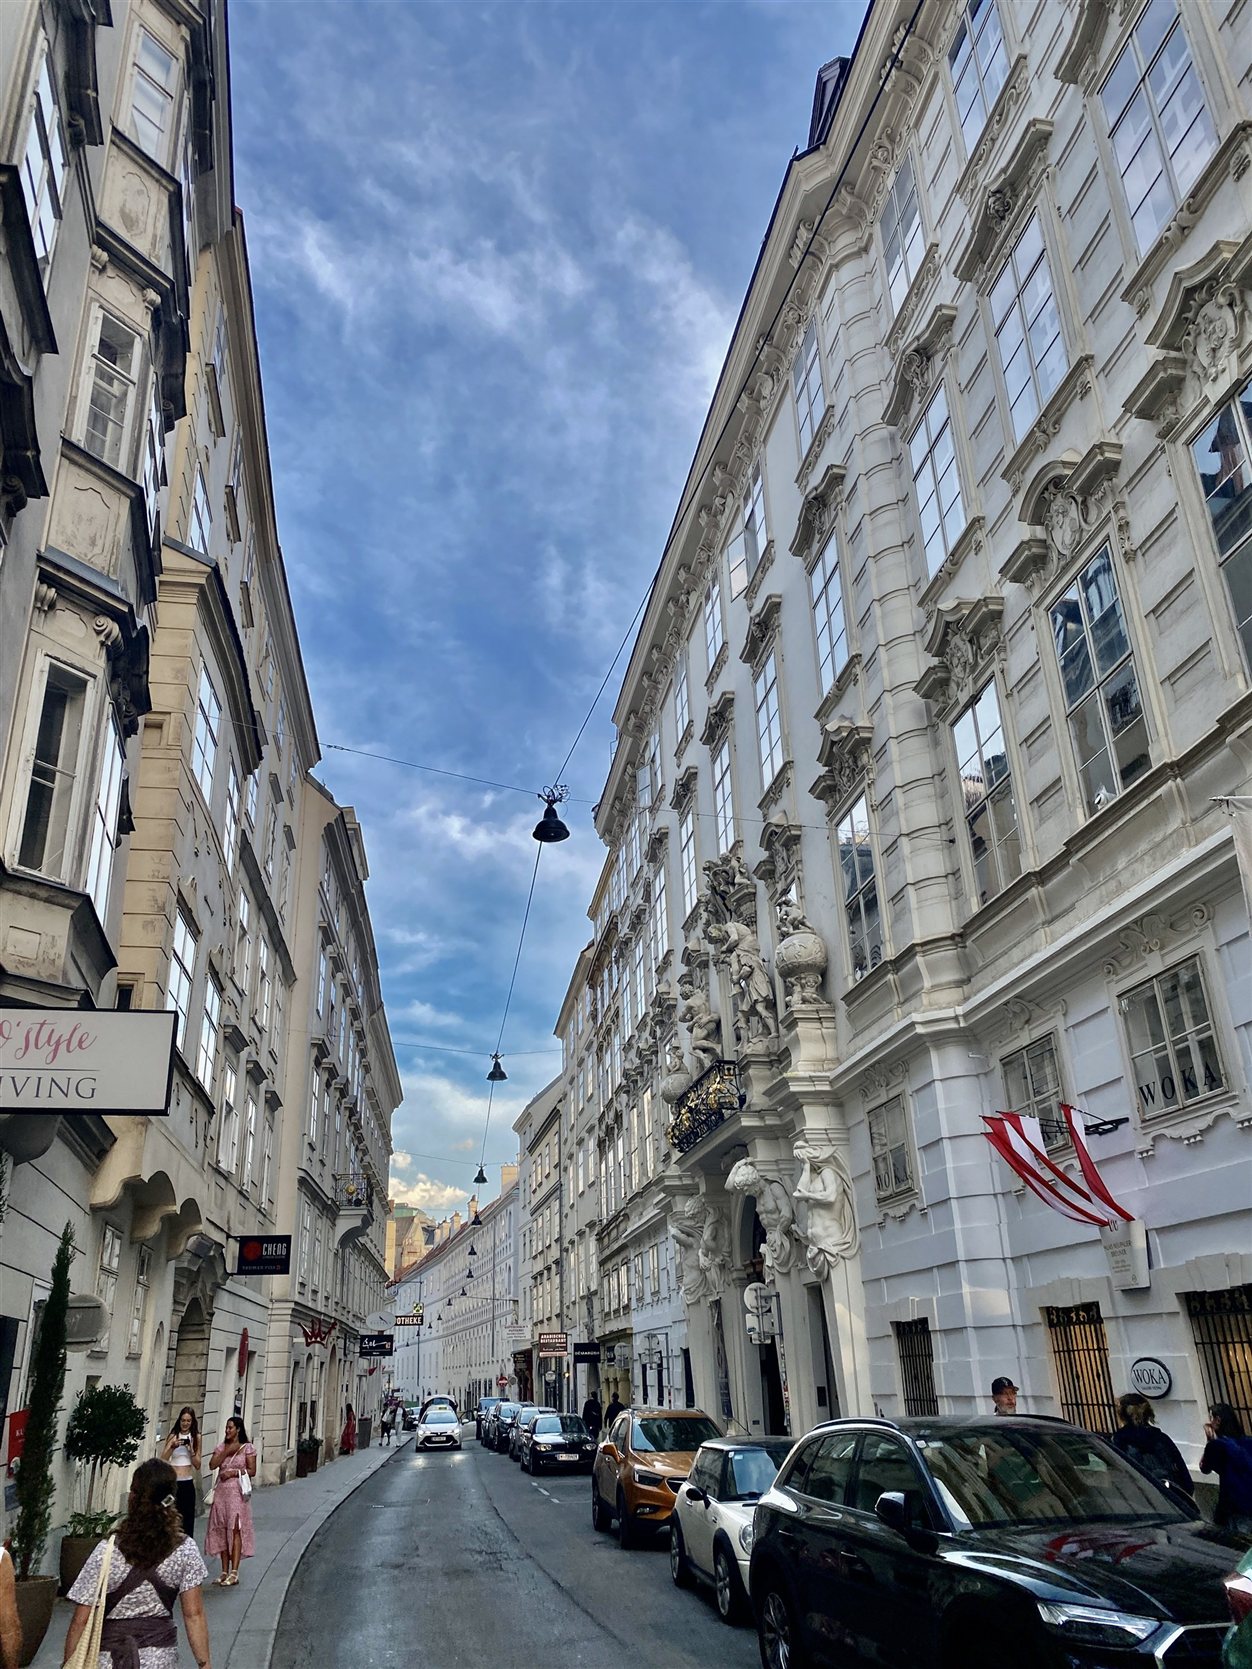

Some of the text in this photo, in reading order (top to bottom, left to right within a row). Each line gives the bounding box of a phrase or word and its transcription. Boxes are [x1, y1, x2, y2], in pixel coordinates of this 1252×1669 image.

[1139, 1061, 1218, 1107] WOKA
[396, 1316, 422, 1325] OTHEKE
[1132, 1368, 1168, 1385] WOKA
